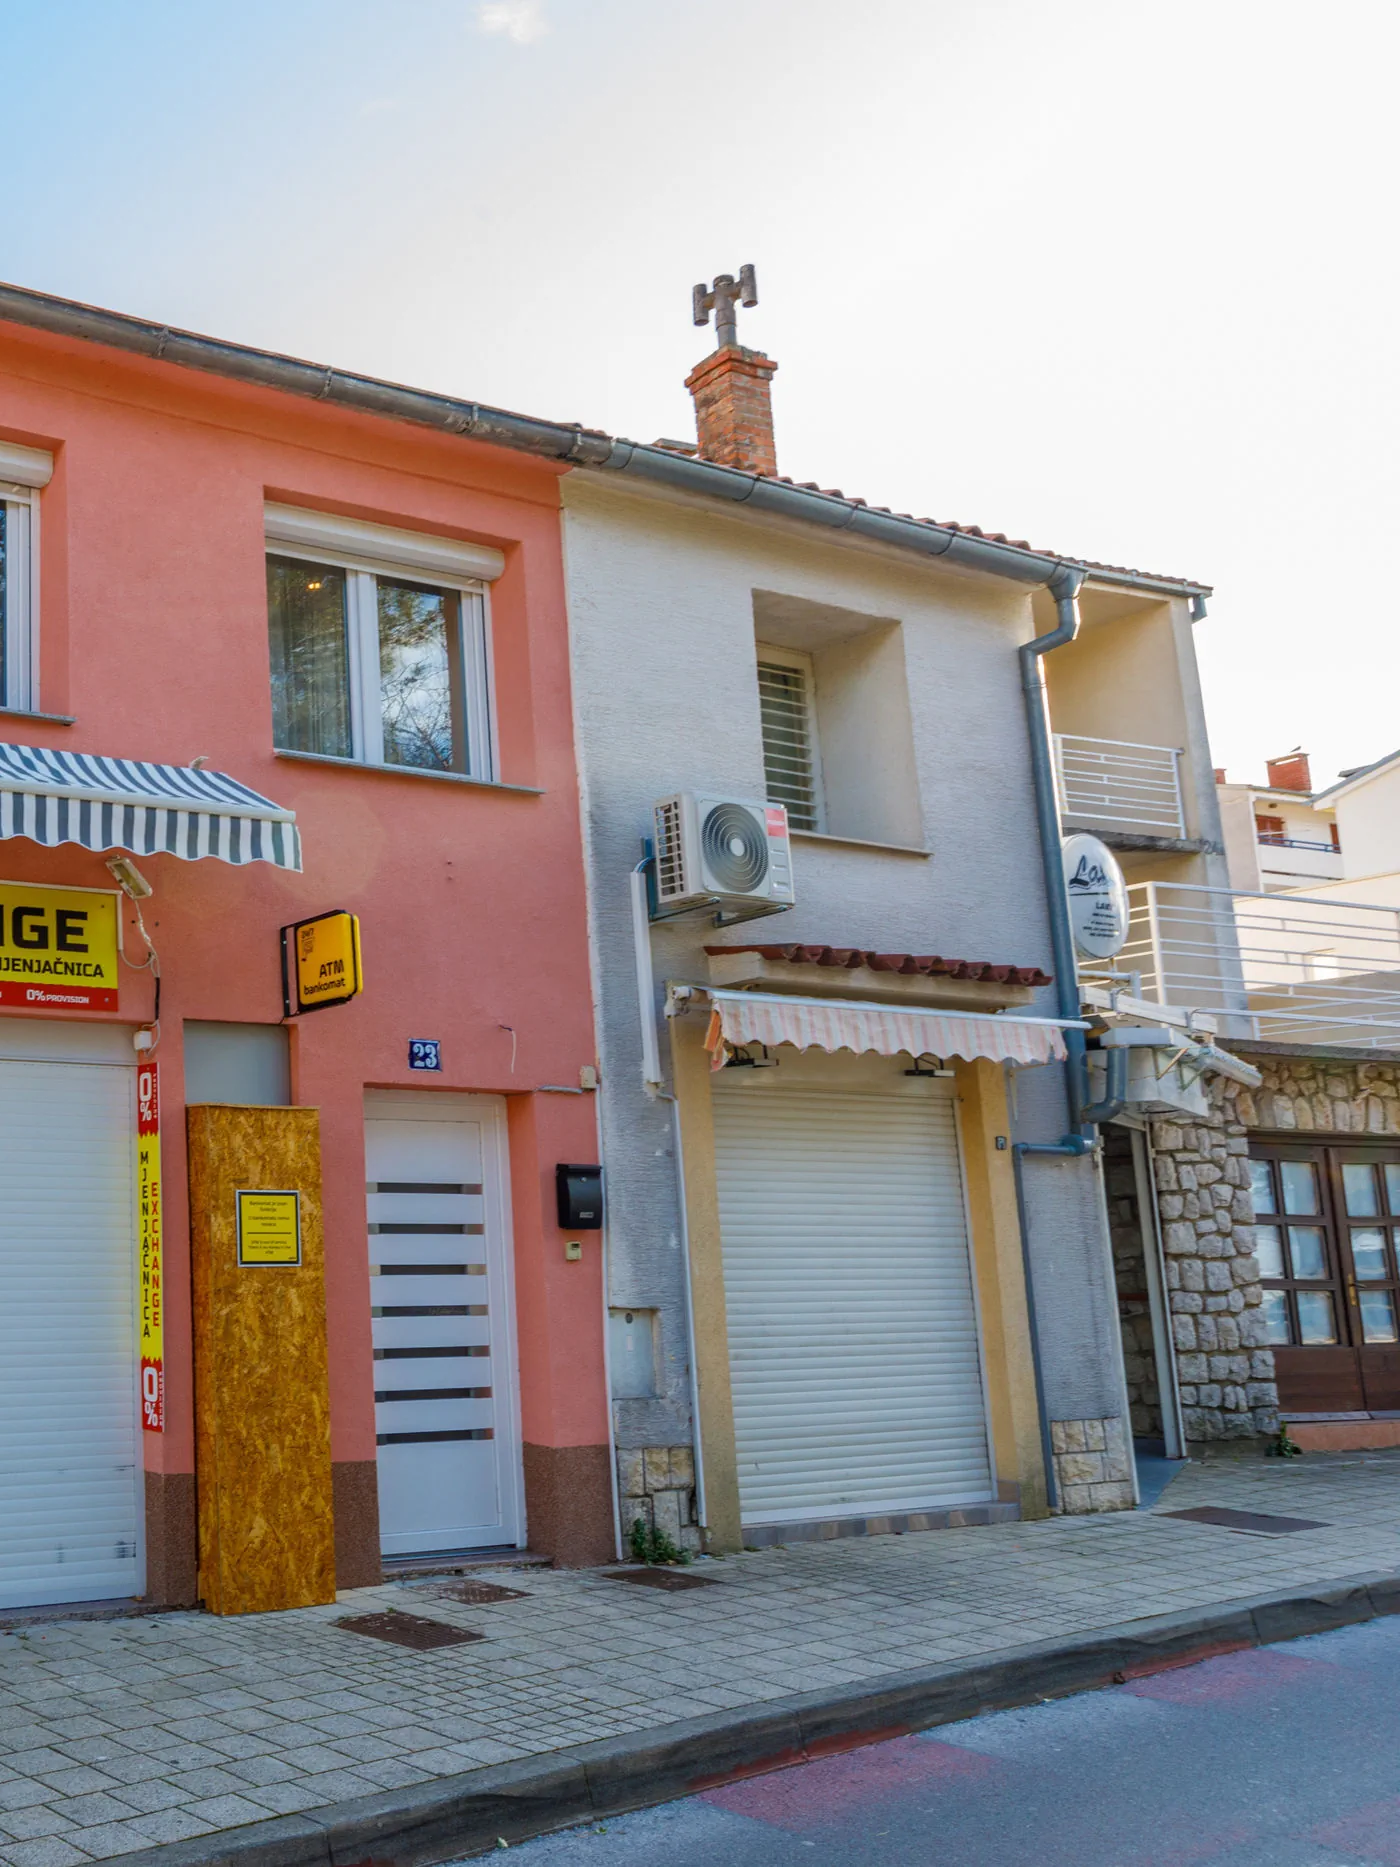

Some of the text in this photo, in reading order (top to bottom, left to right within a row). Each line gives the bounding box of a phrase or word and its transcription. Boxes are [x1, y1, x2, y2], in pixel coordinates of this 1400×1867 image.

[318, 958, 345, 979] ATM
[26, 988, 46, 1002] 0%
[46, 994, 90, 1004] PROVISION
[303, 977, 346, 996] bankomat
[412, 1043, 438, 1069] 23
[139, 1071, 153, 1122] 0%
[151, 1181, 160, 1327] EXCHANGE
[143, 1366, 159, 1428] 0%
